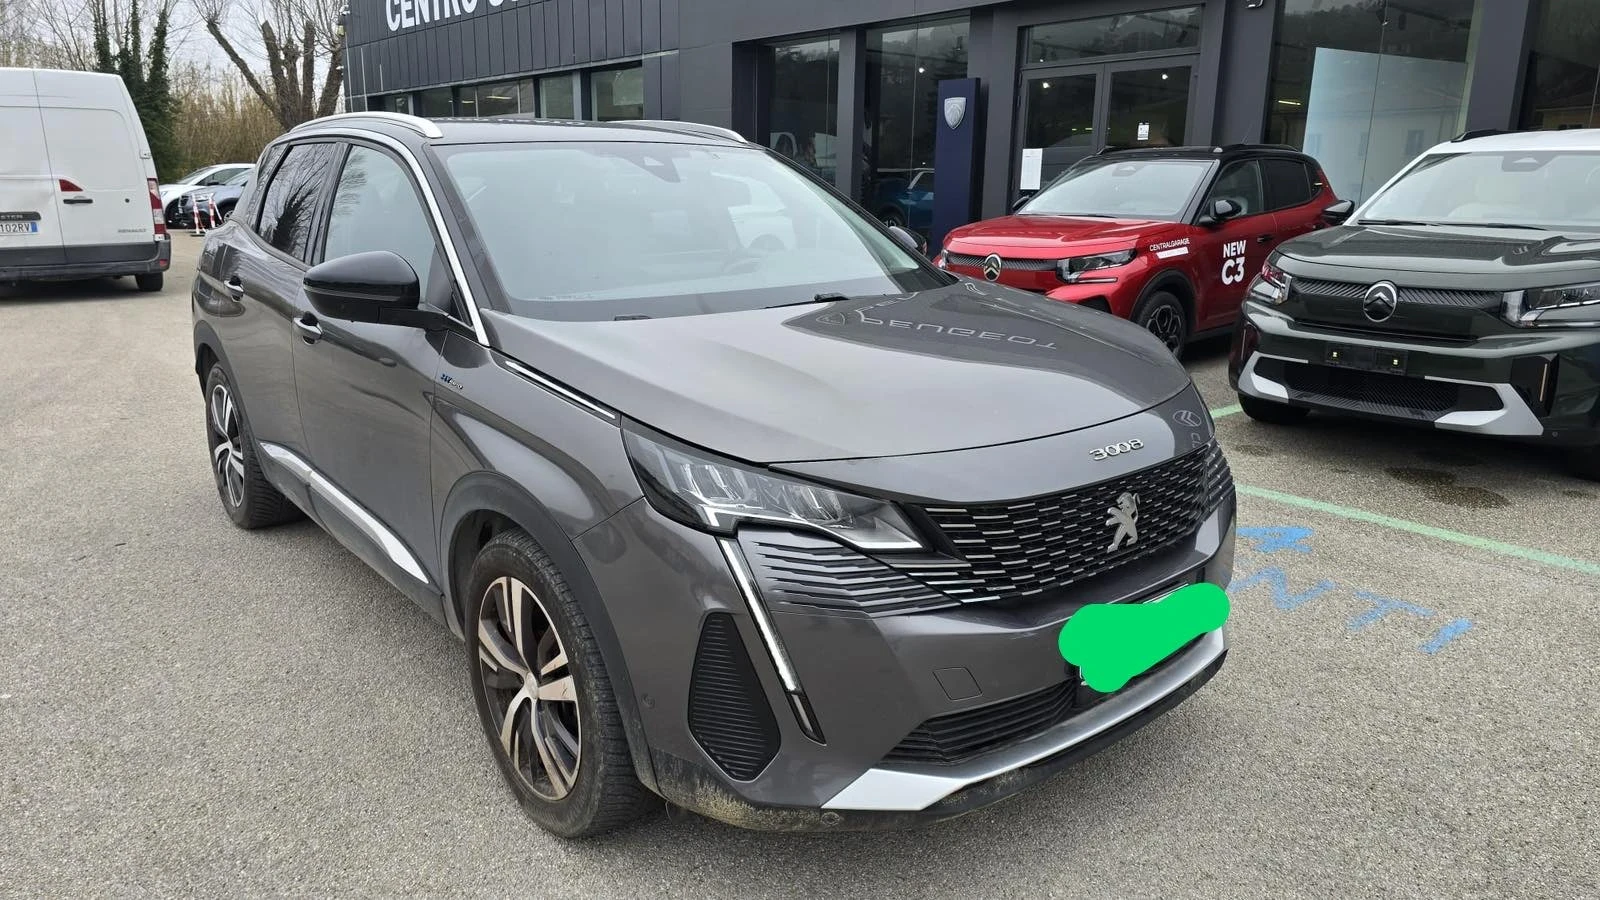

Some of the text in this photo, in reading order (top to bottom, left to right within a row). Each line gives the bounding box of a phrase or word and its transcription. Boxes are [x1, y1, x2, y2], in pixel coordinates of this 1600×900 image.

[1149, 238, 1190, 252] CENTRALGARAGE
[1223, 240, 1247, 259] NEW
[1221, 256, 1246, 285] C3
[1089, 438, 1144, 461] 3008
[1225, 565, 1474, 655] NTI
